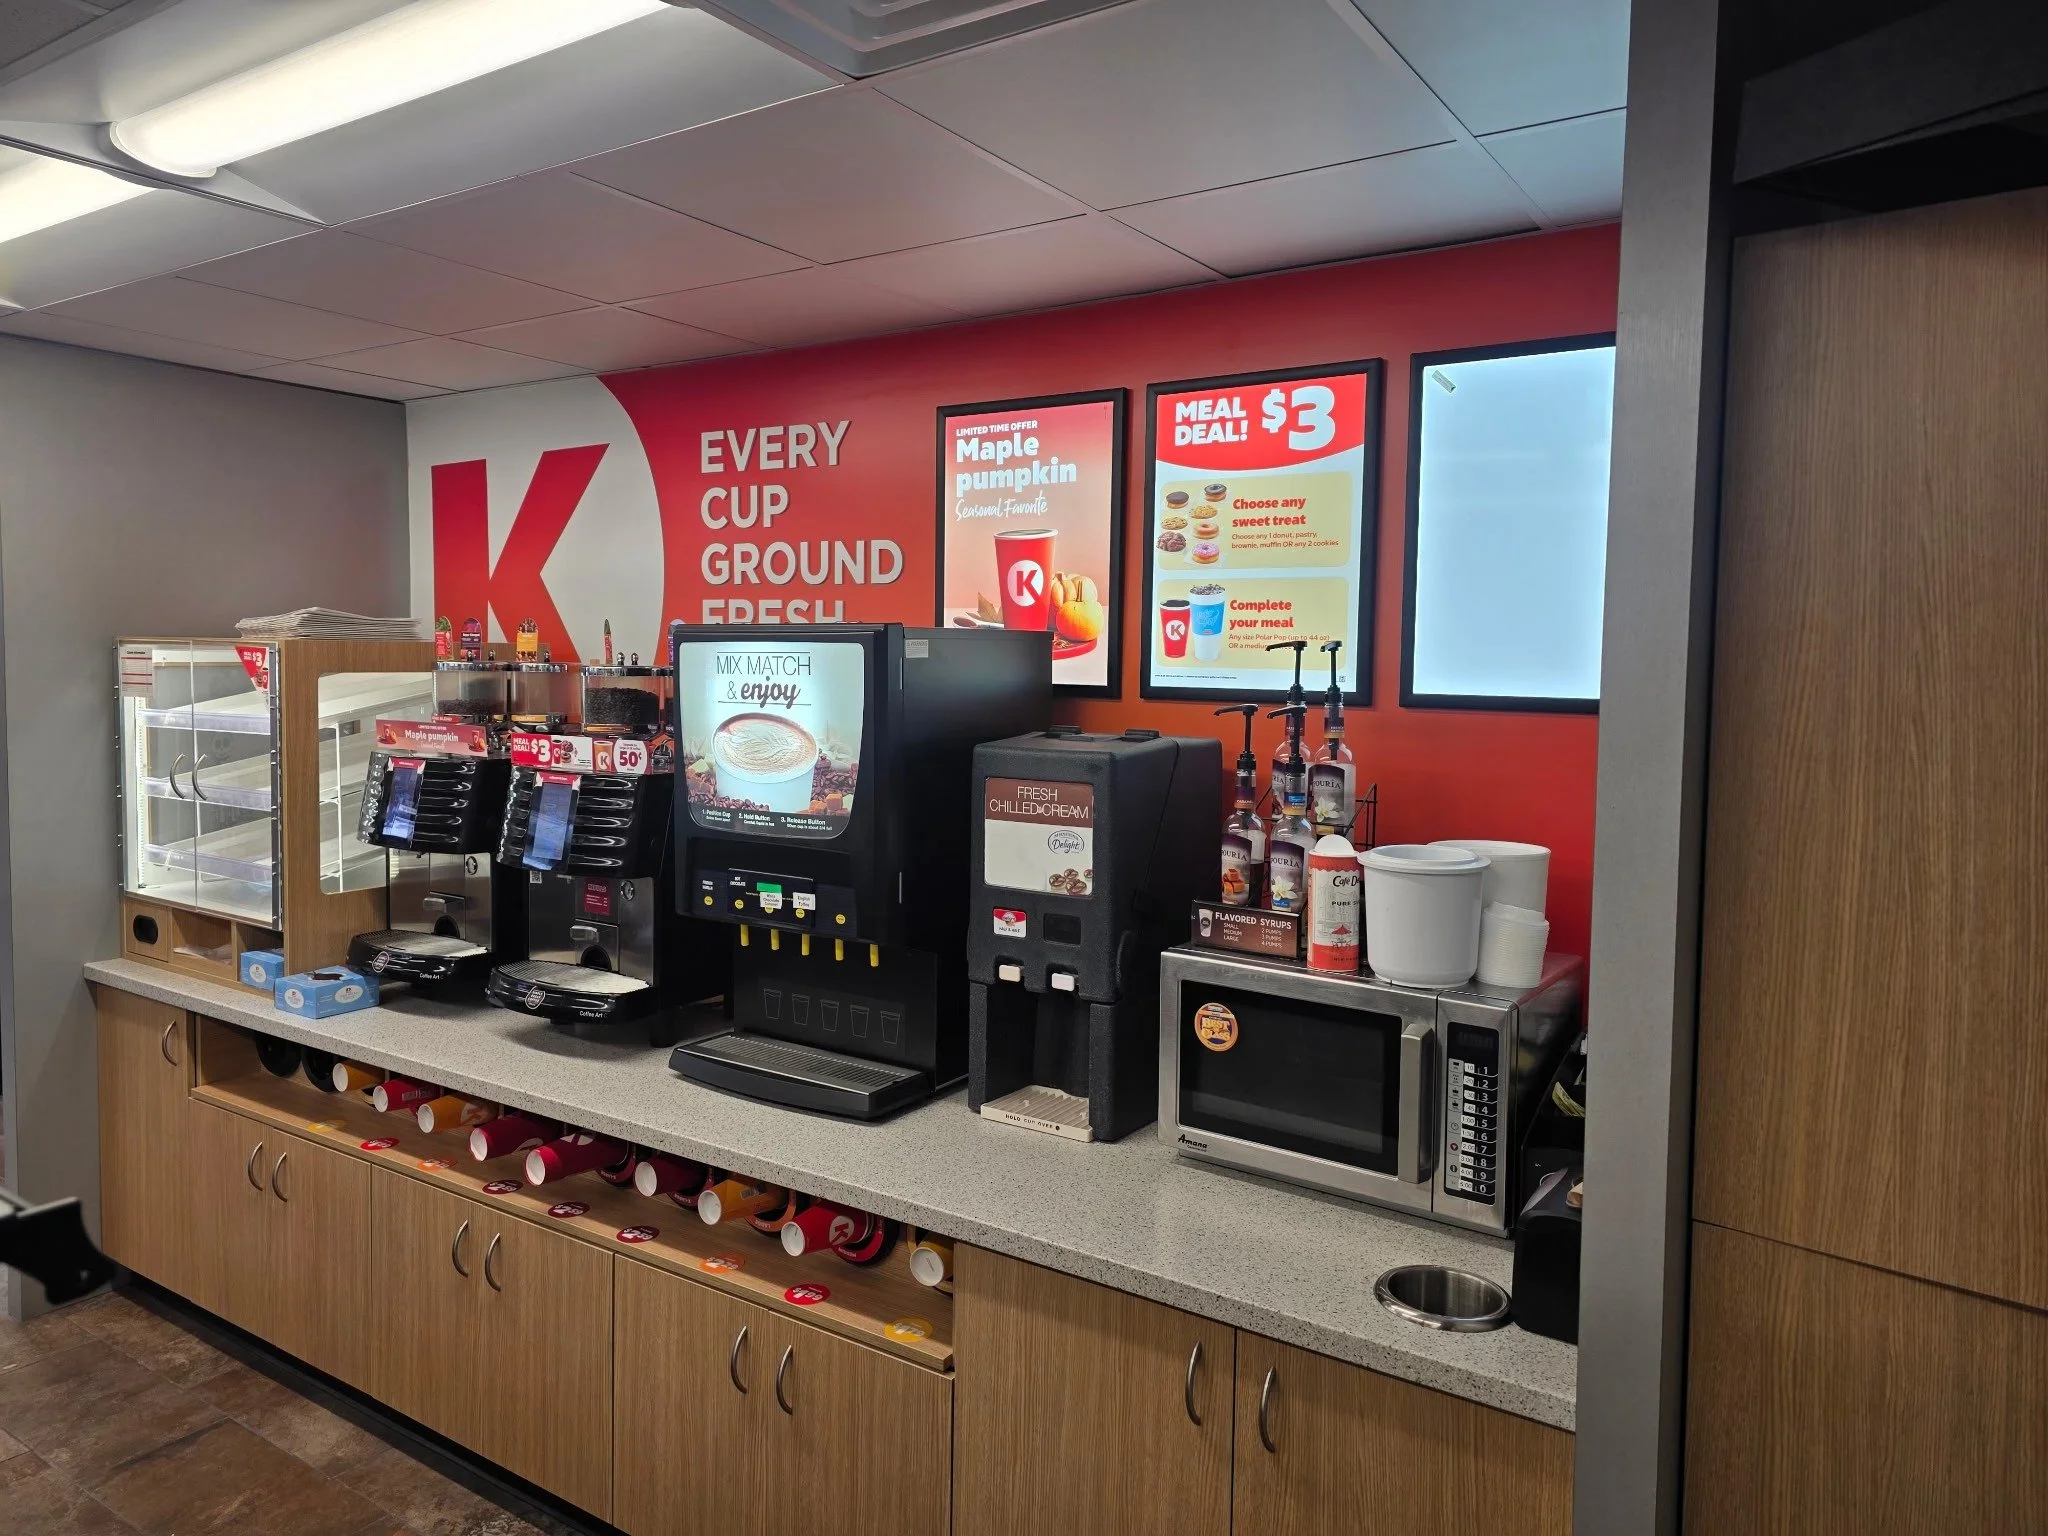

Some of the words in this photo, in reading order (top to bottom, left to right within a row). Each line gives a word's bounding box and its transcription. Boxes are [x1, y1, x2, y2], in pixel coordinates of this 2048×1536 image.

[1175, 396, 1247, 423] MEAL
[1261, 385, 1336, 450] $3
[956, 425, 988, 437] LIMITED
[990, 423, 1009, 434] TIME
[1010, 420, 1038, 432] OFFER
[1174, 420, 1248, 447] DEAL!
[700, 420, 850, 474] EVERY
[956, 432, 1040, 465] Maple
[956, 456, 1077, 497] pumpkin
[700, 484, 789, 530] CUP
[955, 497, 1004, 522] Seasonal
[1003, 490, 1048, 518] Favorite
[1232, 498, 1279, 510] Choose
[1281, 498, 1306, 510] any
[1232, 516, 1270, 527] sweet
[1272, 514, 1306, 526] treat
[701, 540, 903, 586] GROUND
[1016, 569, 1040, 600] K
[702, 599, 844, 624] FRESH
[1229, 599, 1292, 613] Complete
[1170, 624, 1182, 637] K
[1229, 618, 1258, 630] your
[1260, 617, 1293, 627] meal
[716, 655, 742, 675] MIX
[747, 655, 811, 676] MATCH
[727, 681, 737, 700] &
[740, 676, 801, 709] enjoy
[404, 729, 427, 742] Maple
[427, 731, 459, 743] pumpkin
[513, 744, 530, 752] DEAL!
[530, 739, 550, 762] $3
[600, 755, 609, 766] K
[1017, 786, 1057, 801] FRESH
[989, 799, 1039, 815] CHILLED
[1042, 804, 1089, 819] CREAM
[1052, 839, 1080, 851] Delight
[1333, 875, 1350, 887] Café
[1215, 912, 1257, 925] FLAVORED
[1260, 918, 1292, 930] SYRUPS
[579, 1010, 595, 1018] Coffee
[1483, 1067, 1488, 1075] 1
[1482, 1080, 1488, 1088] 2
[1482, 1093, 1488, 1101] 3
[1481, 1119, 1488, 1128] 5
[1177, 1134, 1208, 1149] Amana
[1481, 1132, 1488, 1141] 6
[1481, 1145, 1487, 1154] 7
[1480, 1158, 1487, 1167] 8
[1480, 1171, 1487, 1180] 9
[1480, 1184, 1487, 1193] 0
